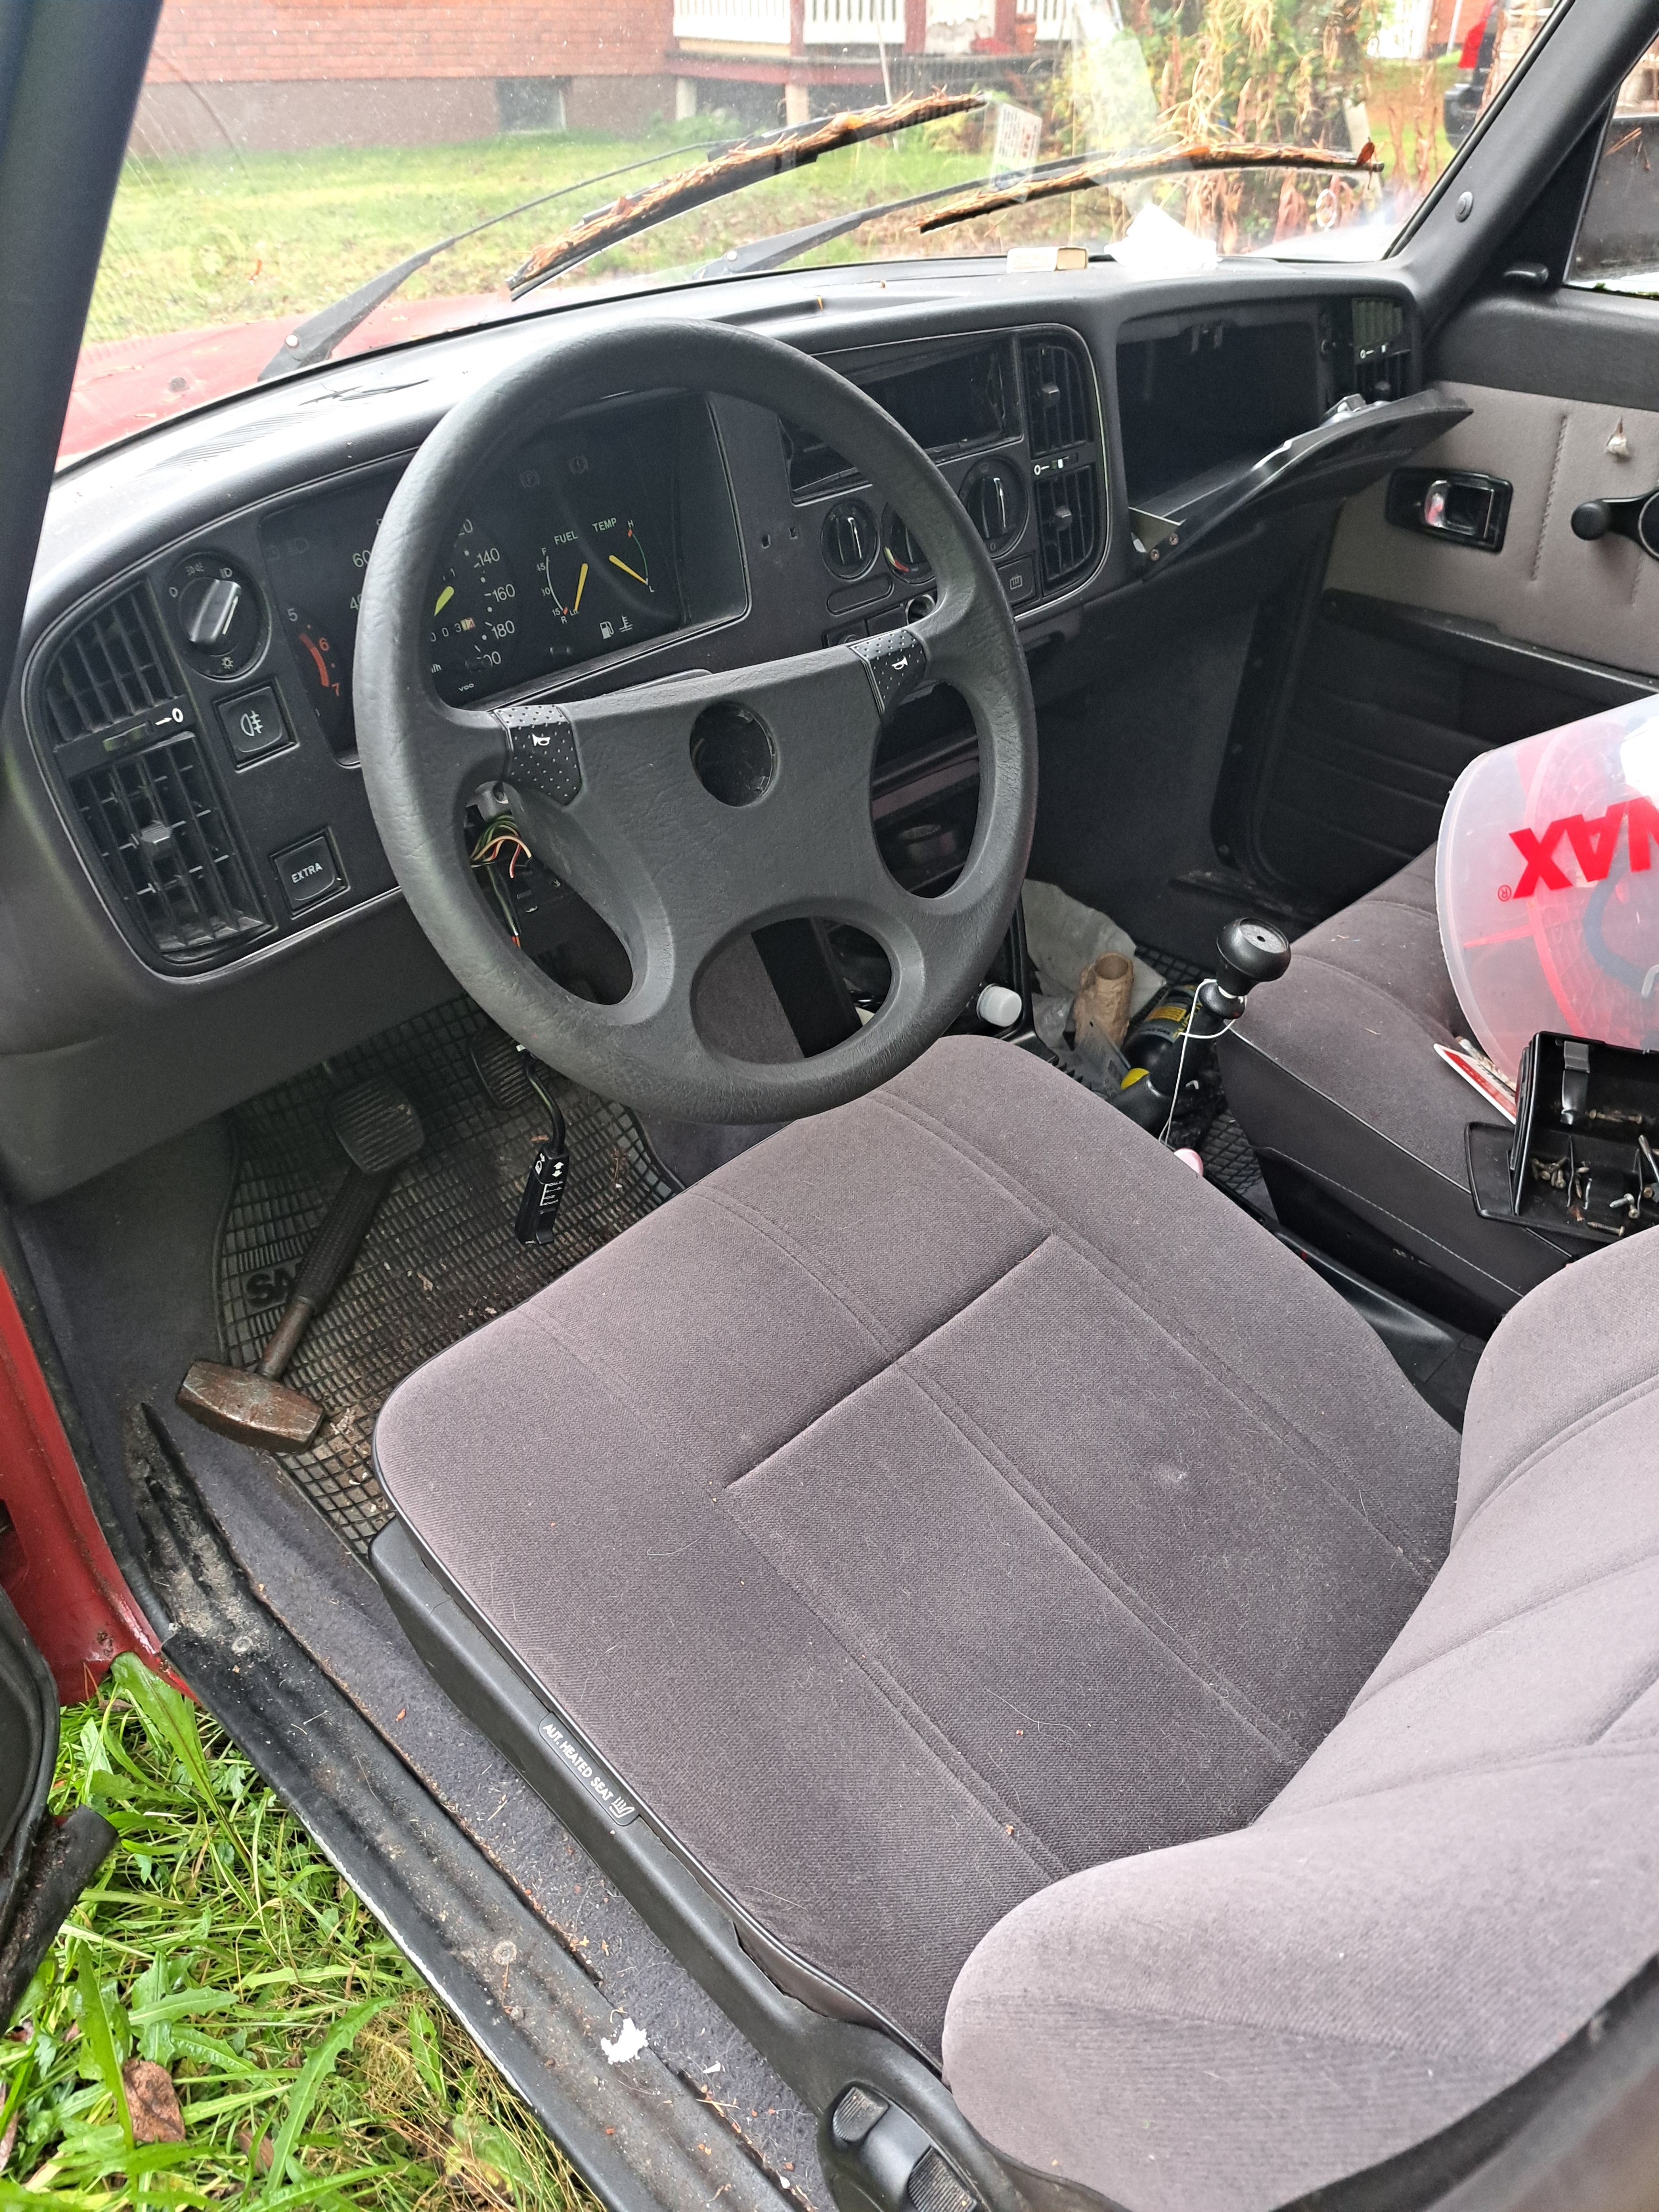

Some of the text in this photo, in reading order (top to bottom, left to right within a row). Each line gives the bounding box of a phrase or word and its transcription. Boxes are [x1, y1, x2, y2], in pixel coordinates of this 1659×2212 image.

[592, 517, 617, 532] TEMP
[627, 520, 634, 528] H
[553, 531, 578, 545] FUEL
[477, 548, 500, 566] 140
[542, 547, 546, 555] F
[492, 584, 515, 602] 160
[288, 608, 298, 622] 5
[552, 608, 561, 616] 15
[560, 616, 567, 624] R
[491, 620, 515, 639] 180
[319, 638, 329, 652] 6
[332, 682, 340, 696] 7
[458, 683, 474, 692] VDO
[291, 863, 323, 883] EXTRA
[542, 1724, 614, 1801] AUT. HEATED SEAT
